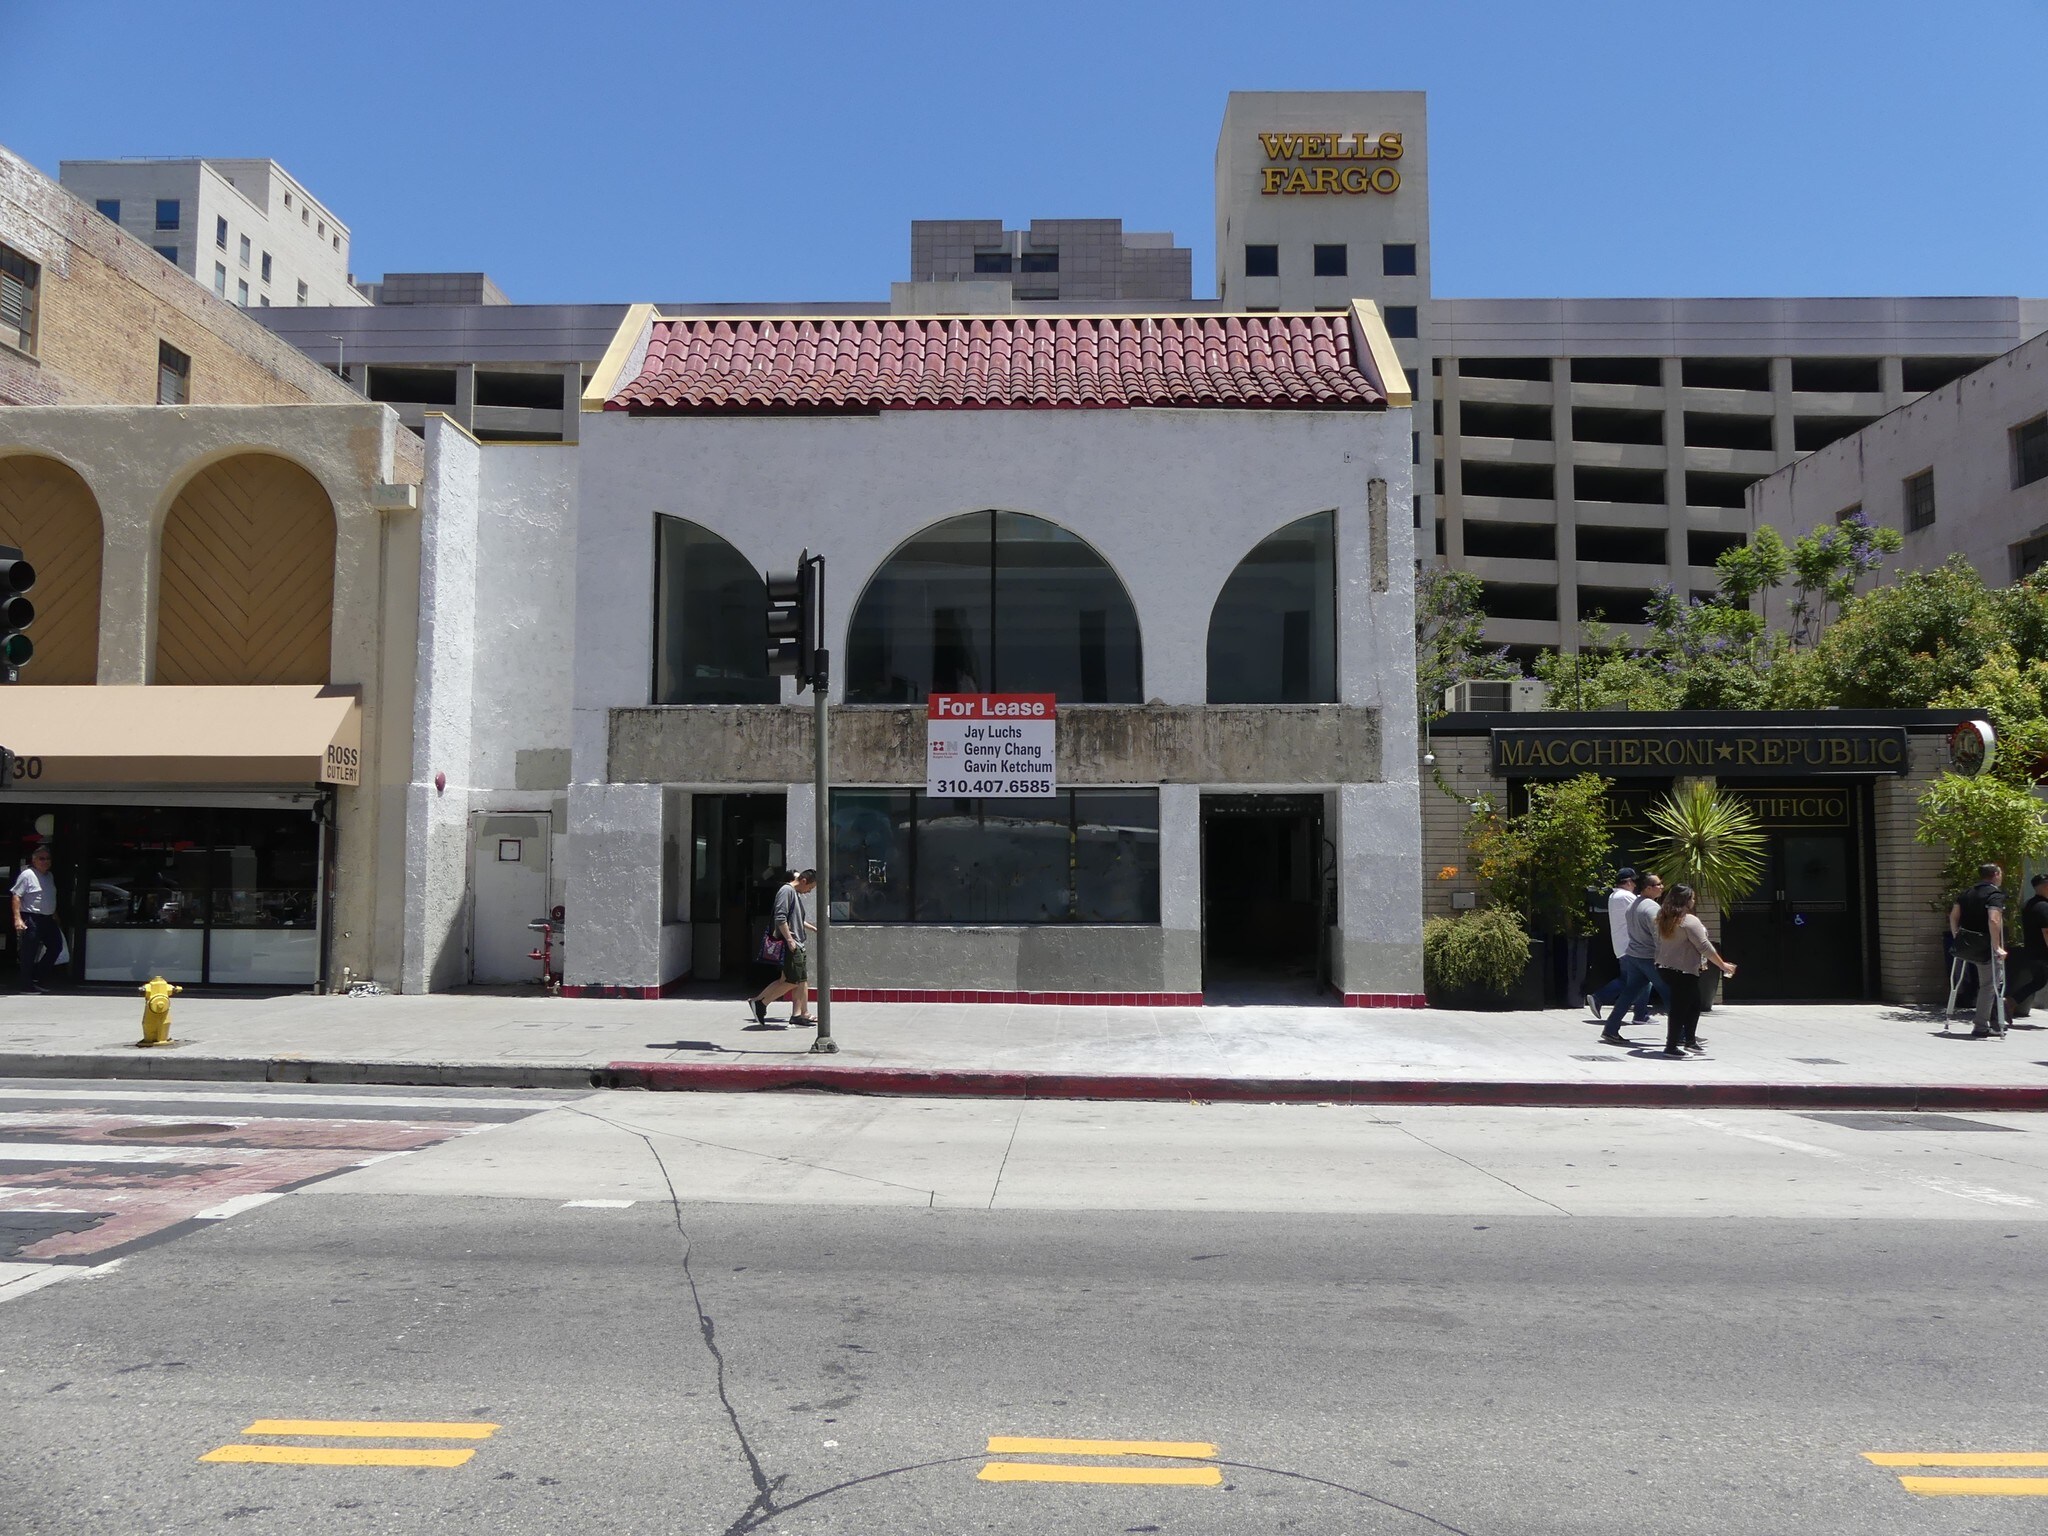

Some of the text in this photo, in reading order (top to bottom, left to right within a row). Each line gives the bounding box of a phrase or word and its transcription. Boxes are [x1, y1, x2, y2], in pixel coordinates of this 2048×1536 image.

[1258, 132, 1404, 161] WELLS
[1261, 167, 1402, 195] FARGO
[938, 697, 1045, 716] For Lease
[964, 725, 1022, 741] Jay Luchs
[327, 744, 358, 766] ROSS
[964, 742, 1042, 758] Genny Chang
[1499, 738, 1903, 767] MACCHERONI REPUBLIC
[326, 764, 358, 782] CUTLERY
[964, 759, 1053, 773] Gavin Ketchum
[937, 780, 1050, 793] 310.407.6585
